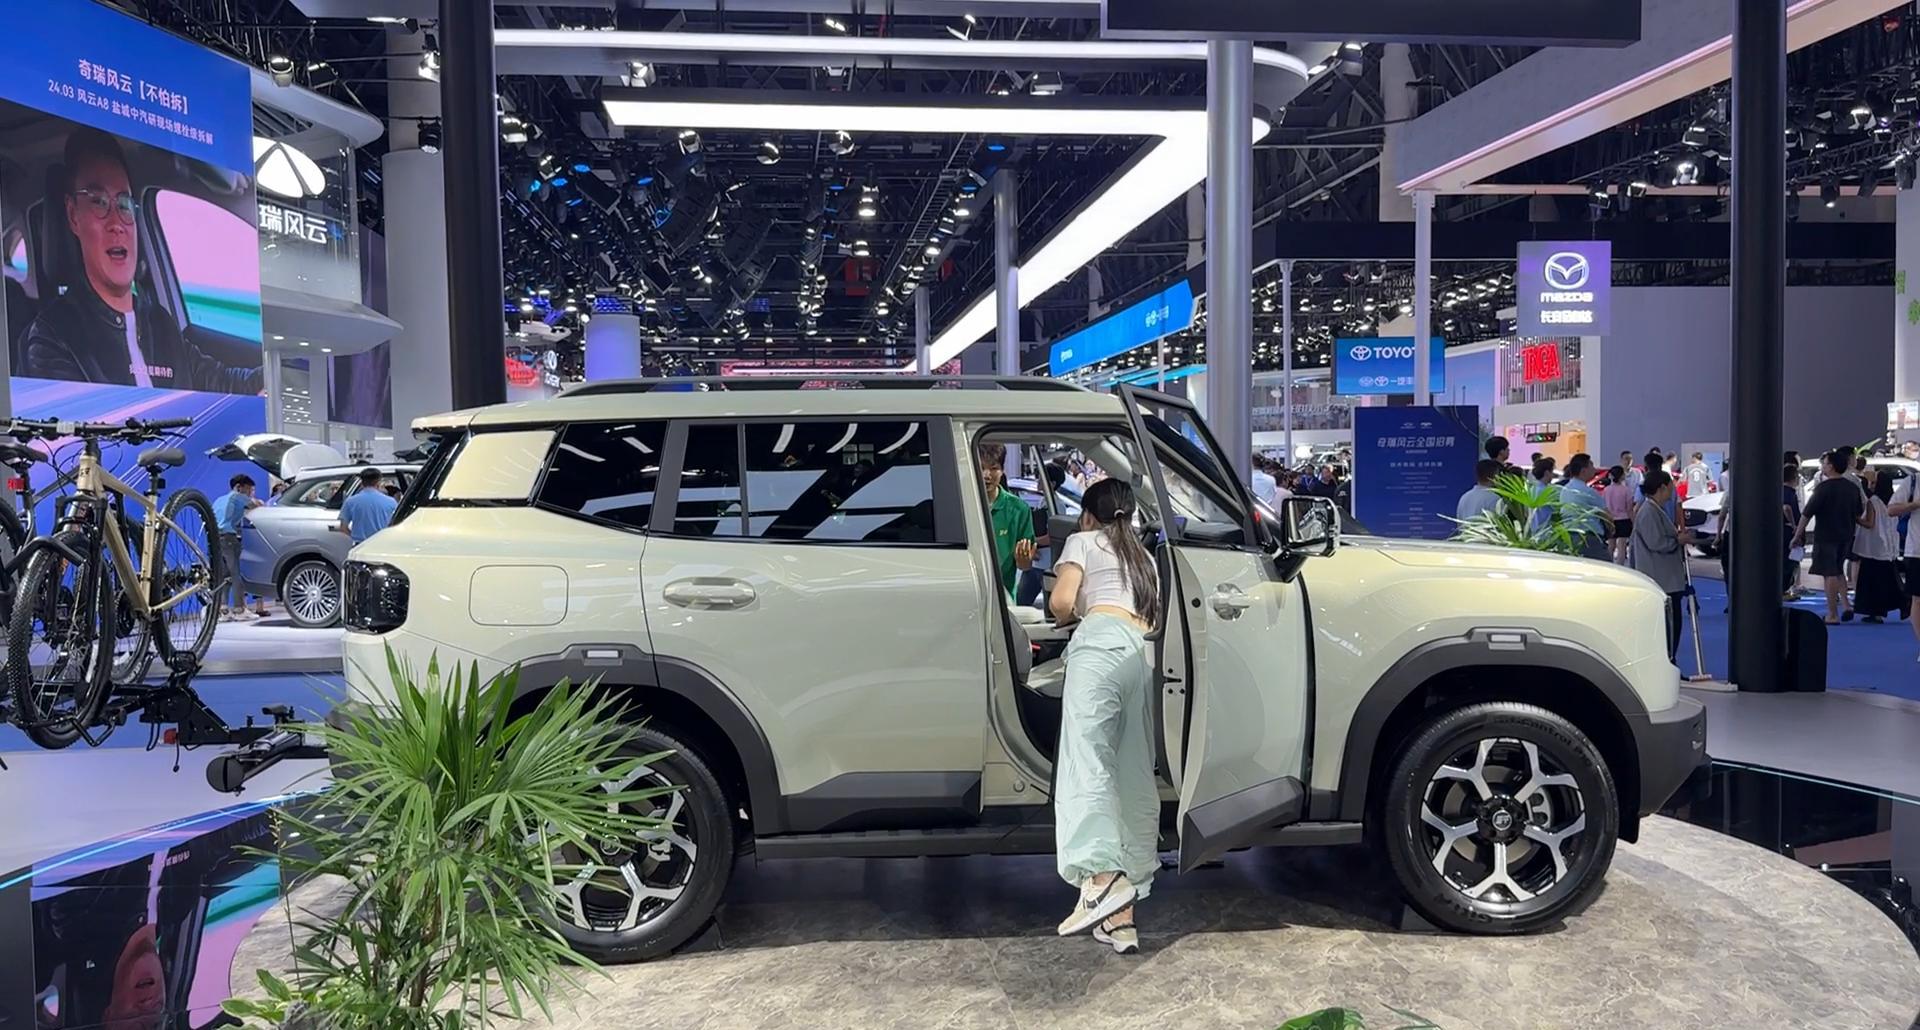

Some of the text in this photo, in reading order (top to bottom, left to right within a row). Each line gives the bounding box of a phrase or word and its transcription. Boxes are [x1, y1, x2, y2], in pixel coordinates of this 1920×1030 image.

[48, 79, 74, 99] 24.03
[77, 88, 109, 110] 风云A8
[258, 203, 328, 244] 瑞风云
